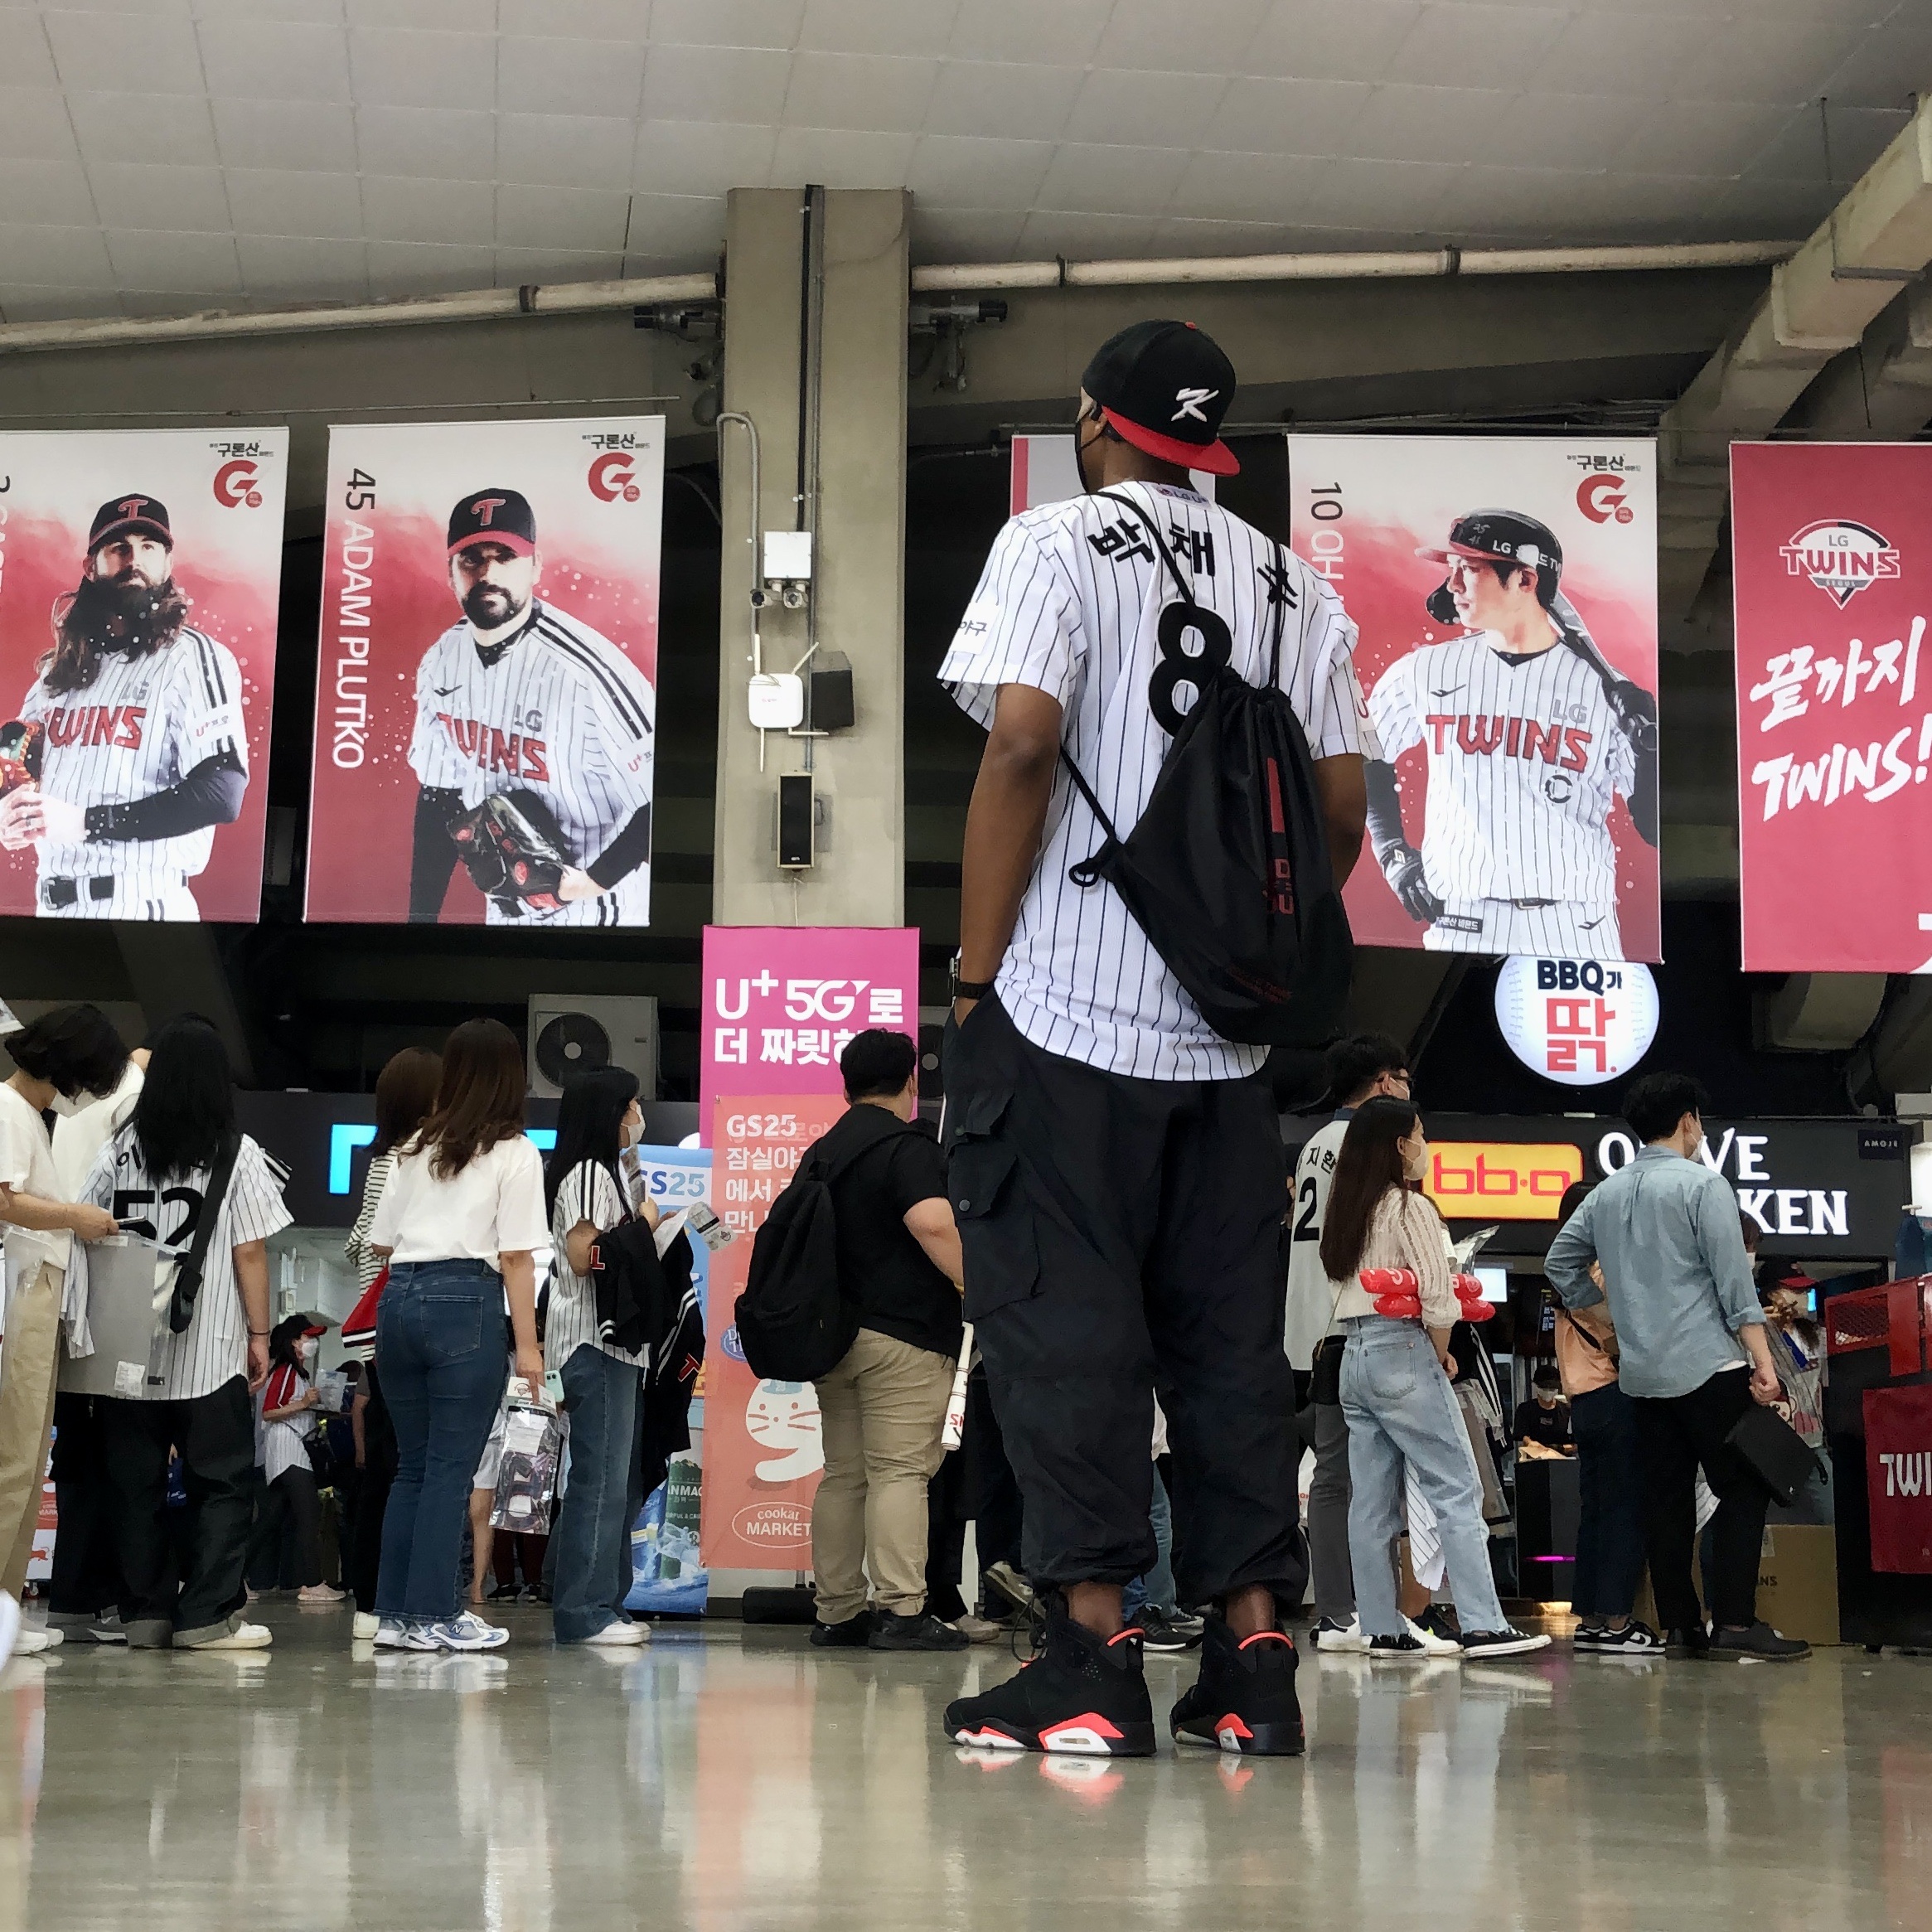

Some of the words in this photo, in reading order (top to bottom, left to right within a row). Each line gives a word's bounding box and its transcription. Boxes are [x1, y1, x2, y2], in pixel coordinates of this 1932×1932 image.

[217, 442, 259, 458] 구론산
[590, 433, 635, 449] 구론산
[1576, 455, 1625, 471] 구론산
[346, 468, 375, 511] 45
[1310, 482, 1343, 521] 10
[470, 498, 506, 526] T
[1310, 530, 1344, 580] OH
[1492, 540, 1512, 554] LG
[1828, 534, 1849, 547] LG
[340, 519, 375, 627] ADAM
[1779, 547, 1901, 578] TWINS
[1147, 600, 1234, 740] 8
[1749, 615, 1927, 733] 끝까지
[332, 635, 370, 769] PLUTKO
[1552, 699, 1588, 724] LG
[45, 705, 148, 751] WINS
[1425, 714, 1593, 774] TWINS
[1750, 713, 1932, 822] TWINS!
[715, 969, 779, 1020] U+
[714, 1027, 748, 1064] 더
[759, 1028, 865, 1066] 짜릿
[726, 1114, 797, 1138] GS25
[1598, 1126, 1770, 1181] OVE
[725, 1178, 772, 1203] 에서
[1293, 1176, 1320, 1242] 2
[113, 1186, 205, 1247] 52
[1879, 1451, 1932, 1497] TWI
[746, 1521, 812, 1537] MARKET
